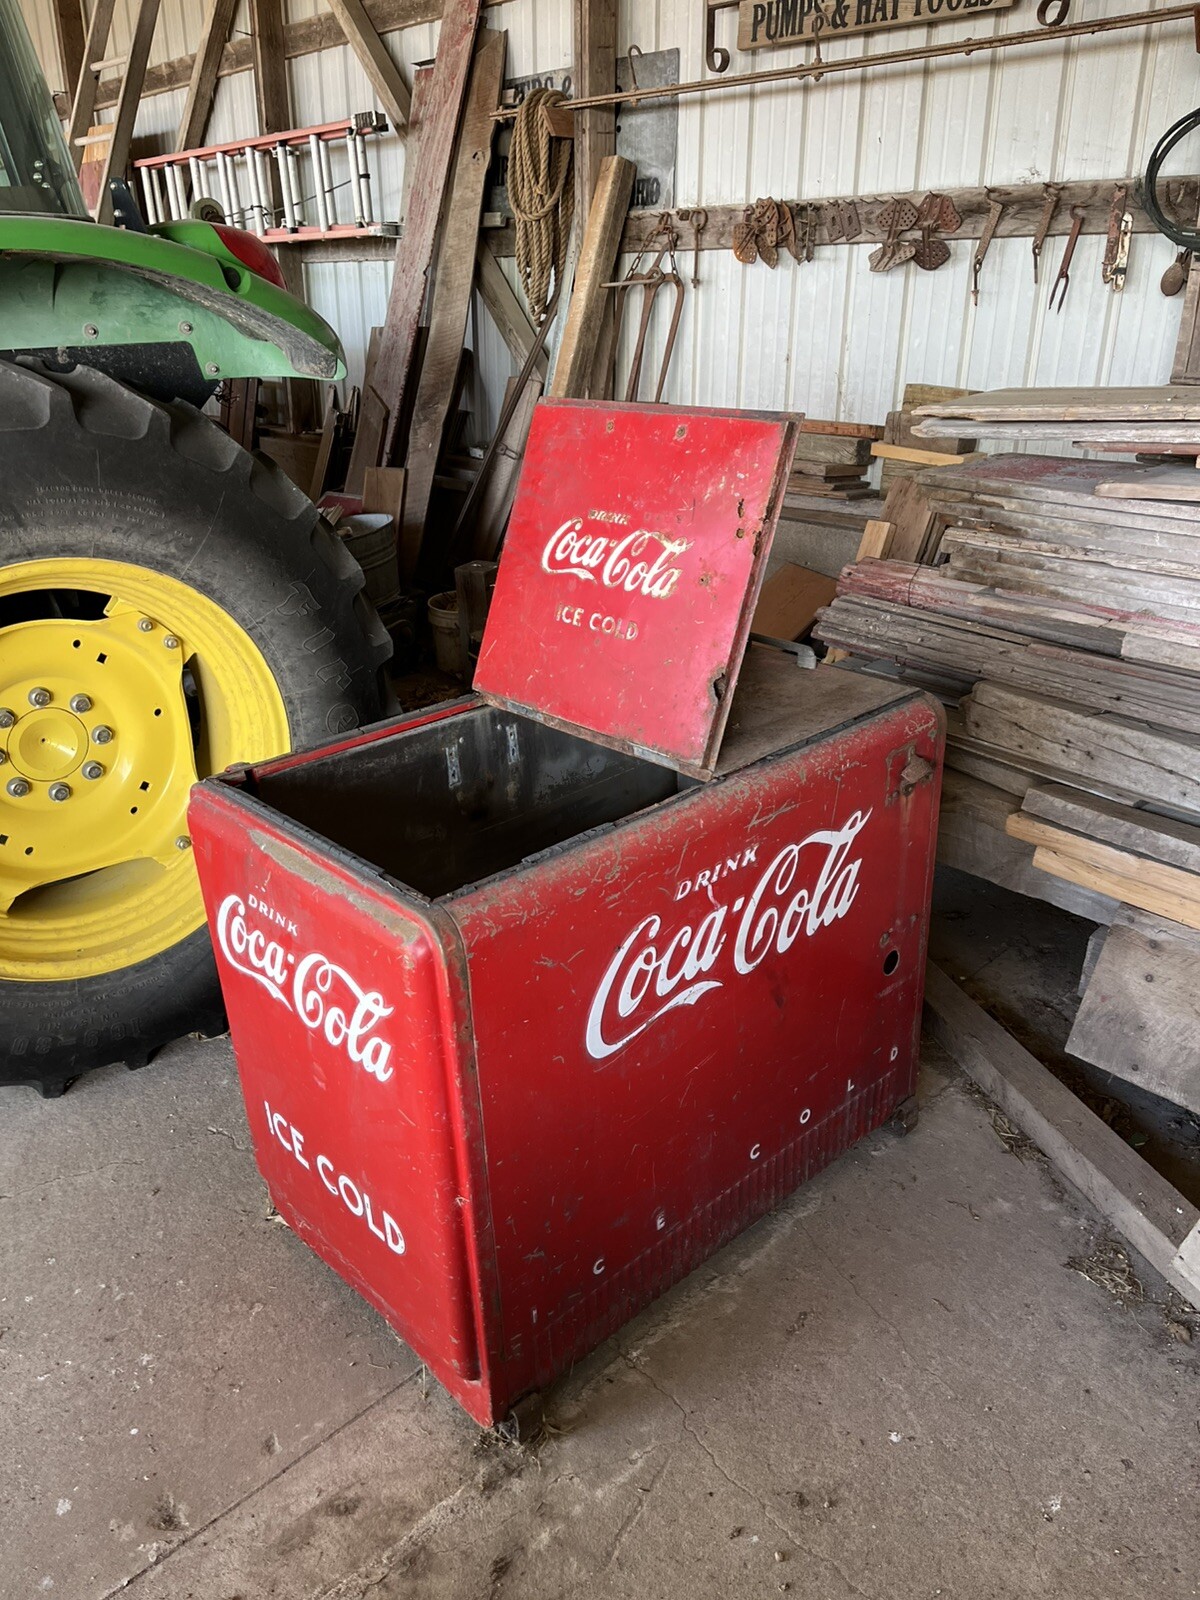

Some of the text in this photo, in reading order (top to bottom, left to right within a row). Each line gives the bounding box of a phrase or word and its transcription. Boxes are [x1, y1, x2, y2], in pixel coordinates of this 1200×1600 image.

[751, 0, 823, 42] PUMPS
[831, 0, 850, 29] &
[588, 509, 631, 525] DRINK
[541, 517, 695, 599] Coca-Cola
[556, 603, 638, 641] ICE COLD
[676, 845, 758, 900] DRINK
[248, 894, 298, 936] DRINK
[585, 807, 873, 1059] Coca-Cola
[217, 894, 394, 1082] Coca-Cola
[264, 1100, 406, 1255] ICE COLD
